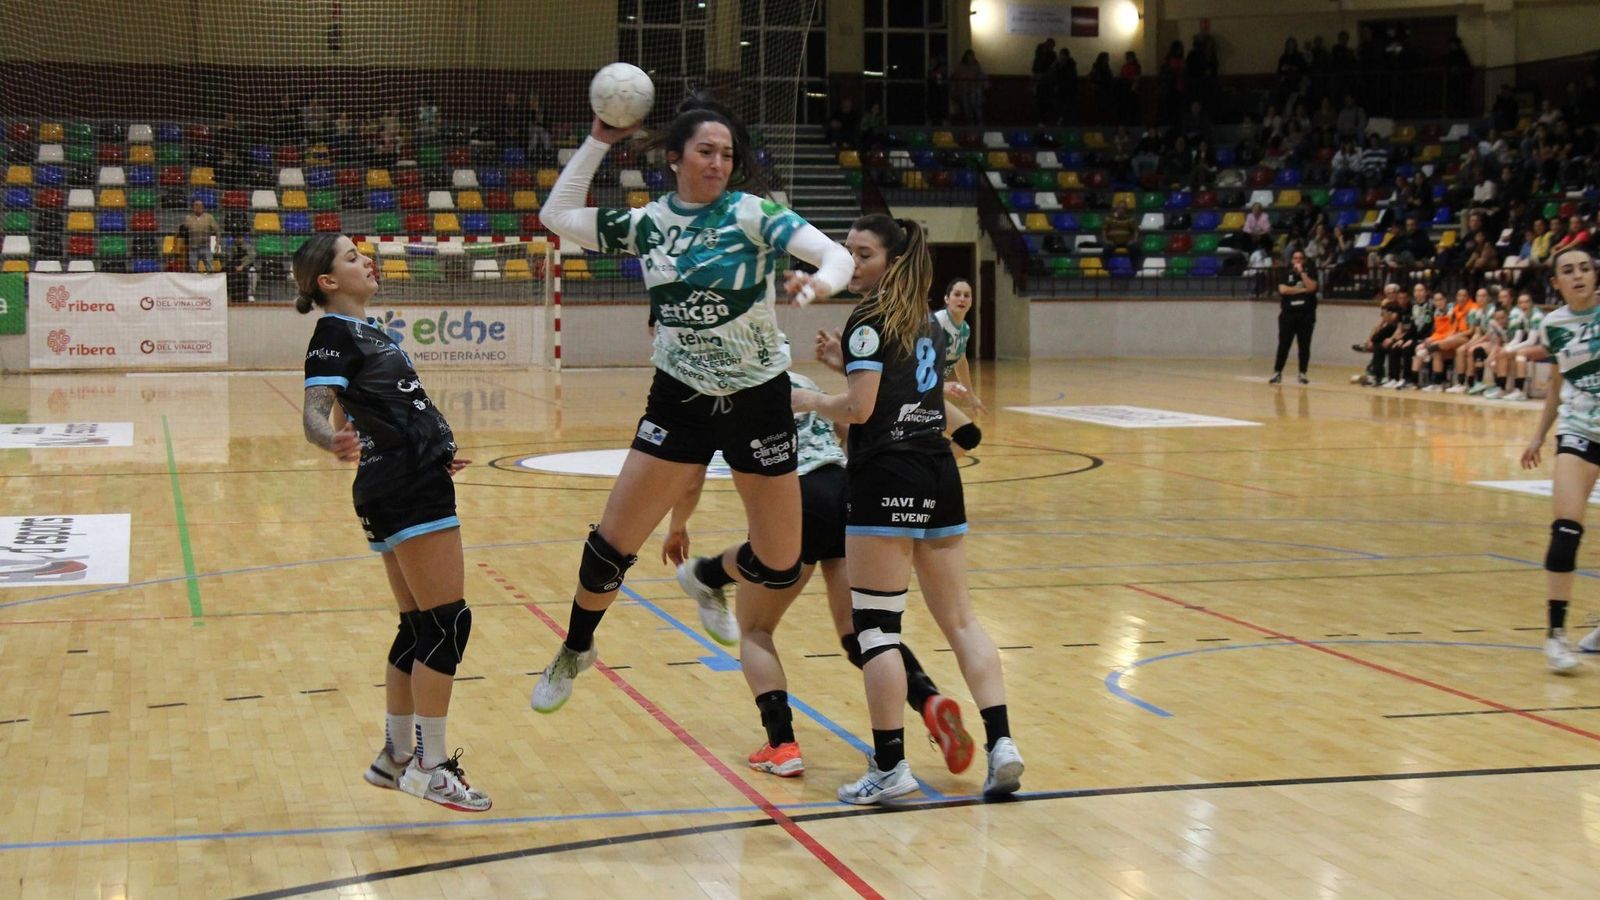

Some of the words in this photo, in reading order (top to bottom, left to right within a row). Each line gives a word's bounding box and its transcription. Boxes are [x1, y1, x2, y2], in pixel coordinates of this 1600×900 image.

[667, 225, 702, 257] 27
[68, 300, 115, 312] ribera
[412, 310, 505, 345] elche
[68, 344, 116, 355] ribera
[414, 349, 507, 361] MEDITERRÁNEO
[916, 337, 938, 393] 8
[760, 452, 790, 466] tesla
[881, 497, 914, 507] JAVI
